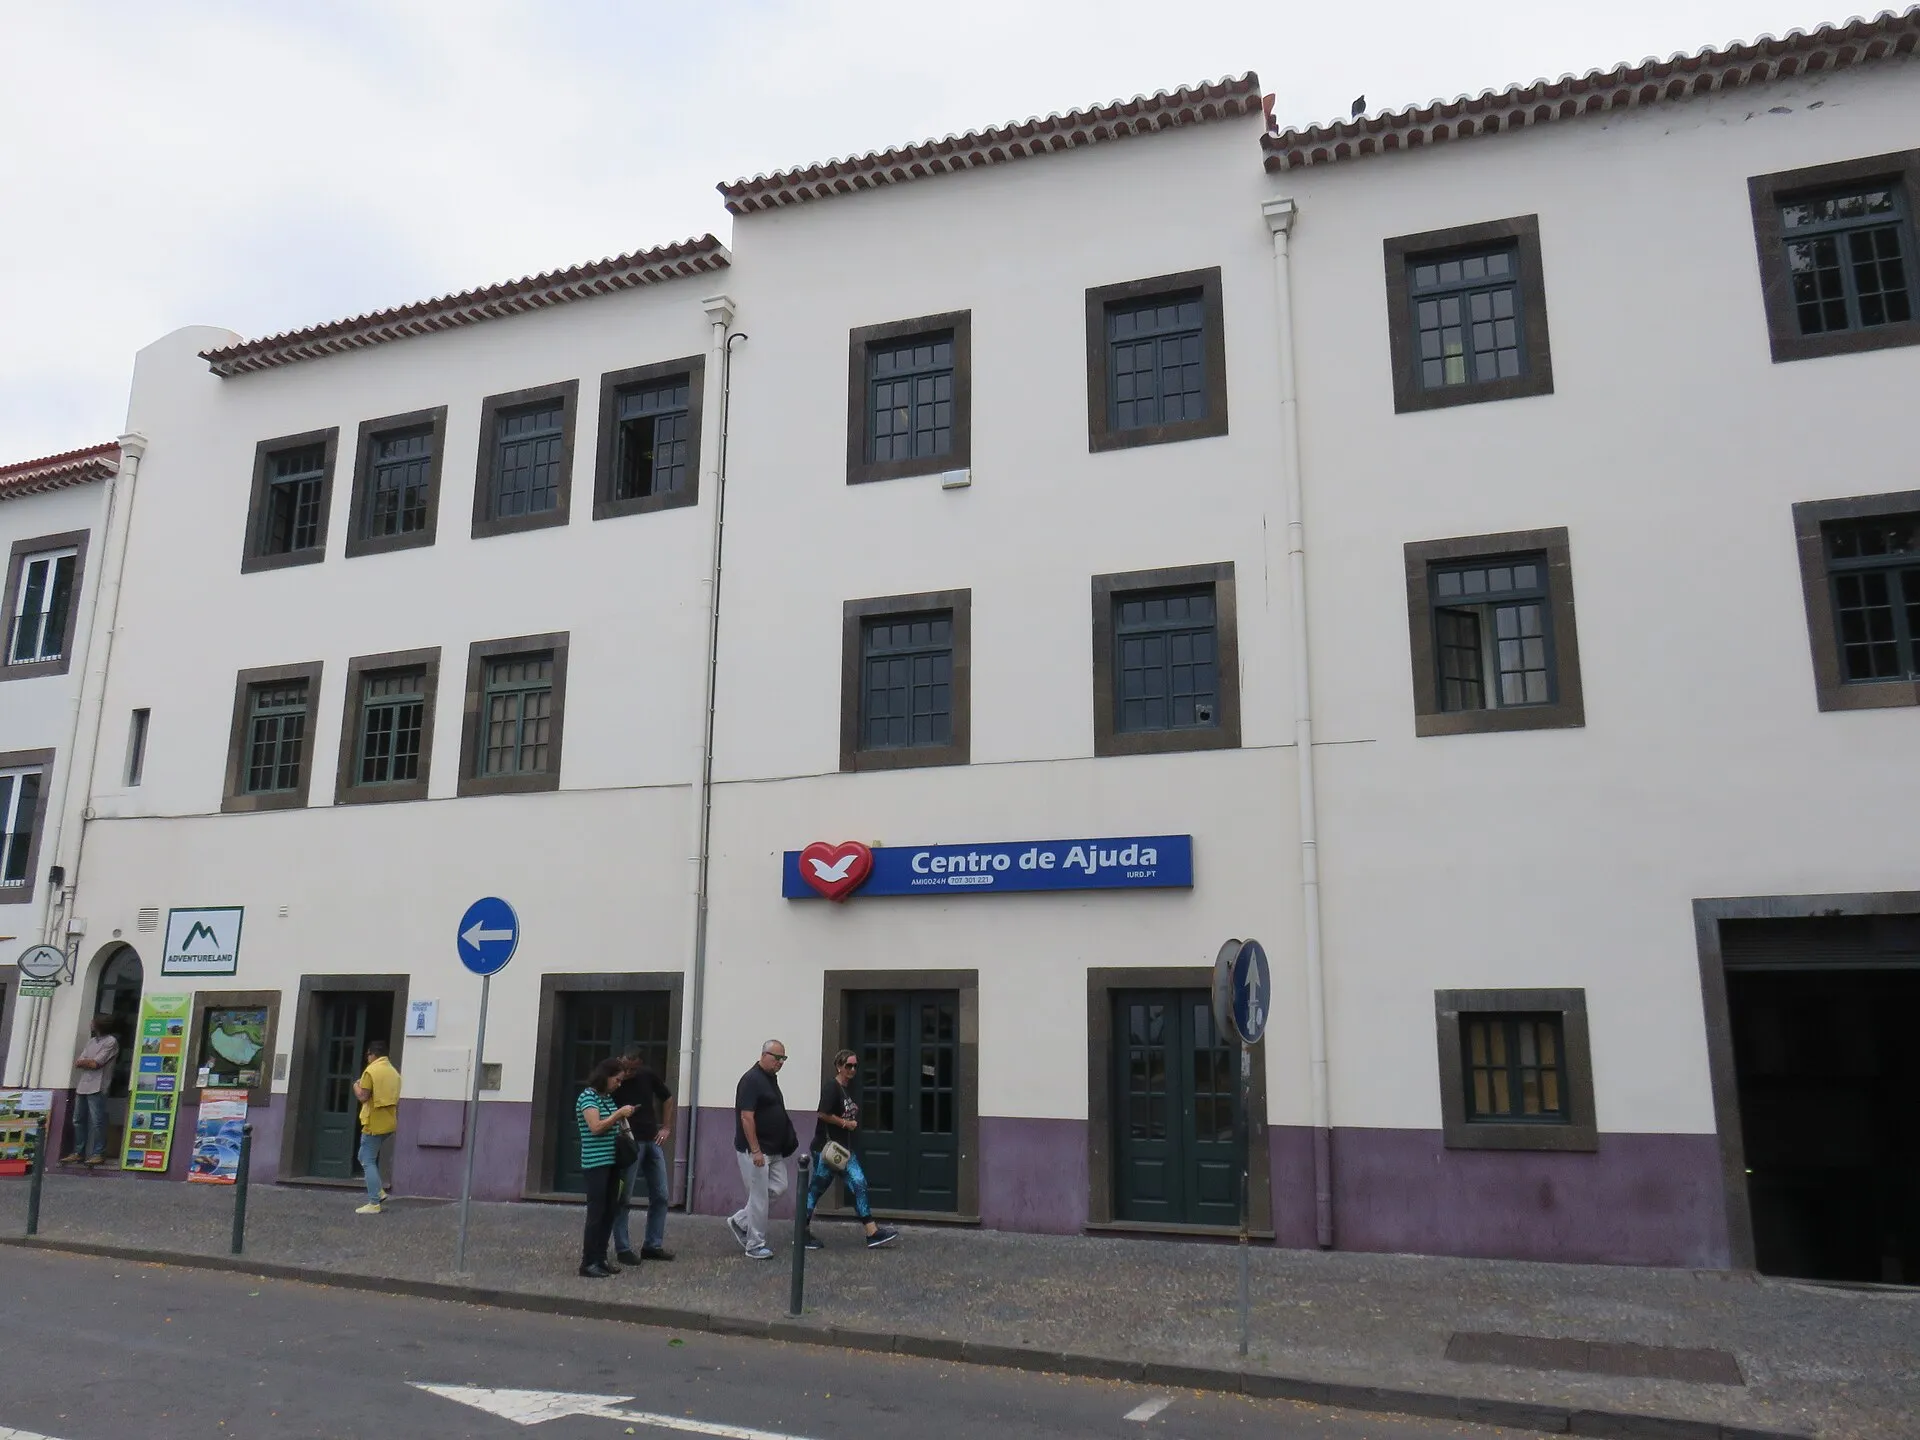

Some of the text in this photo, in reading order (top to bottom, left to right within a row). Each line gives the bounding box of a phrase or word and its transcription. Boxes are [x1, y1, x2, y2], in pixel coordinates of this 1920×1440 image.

[911, 844, 1158, 875] Centro de Ajuda
[1126, 870, 1157, 878] IURD.PT
[911, 877, 947, 886] AMIGO24H
[951, 877, 963, 885] 707
[167, 954, 233, 963] ADVENTURELAND
